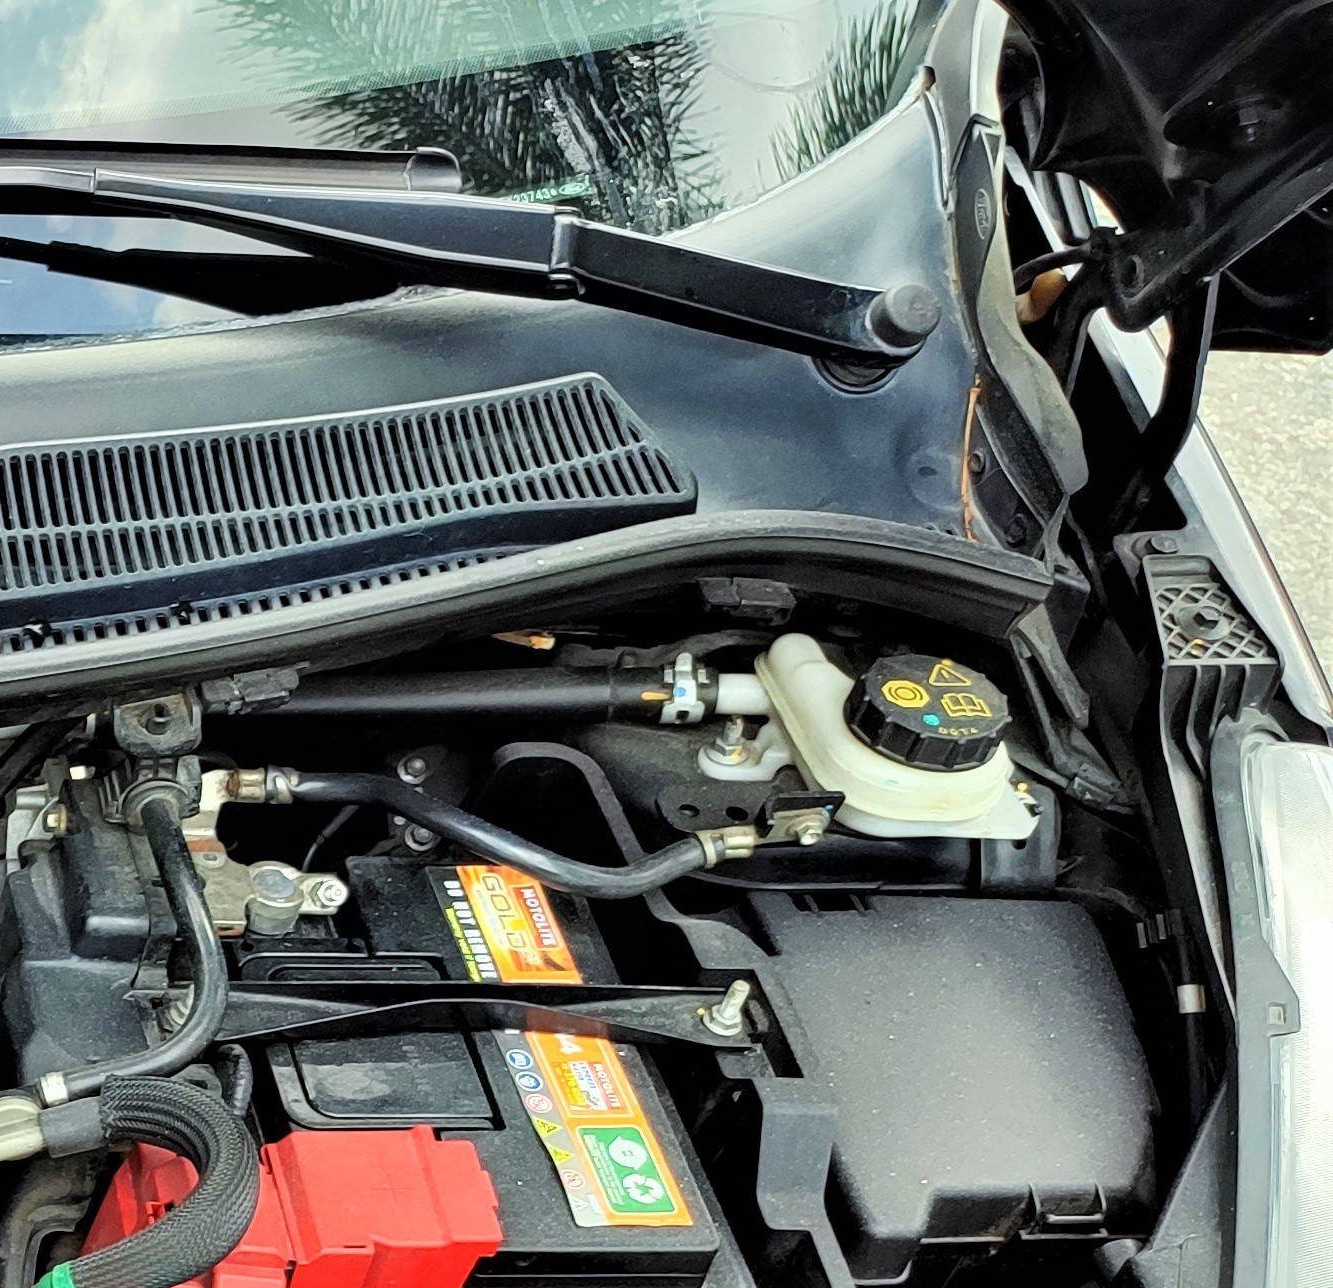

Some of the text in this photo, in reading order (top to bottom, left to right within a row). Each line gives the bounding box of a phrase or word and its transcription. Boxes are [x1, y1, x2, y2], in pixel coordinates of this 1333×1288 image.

[481, 874, 527, 949] GOLD
[520, 887, 558, 946] MOTOLITE
[463, 929, 497, 979] REMOVE
[593, 1063, 622, 1108] MOTOLITE
